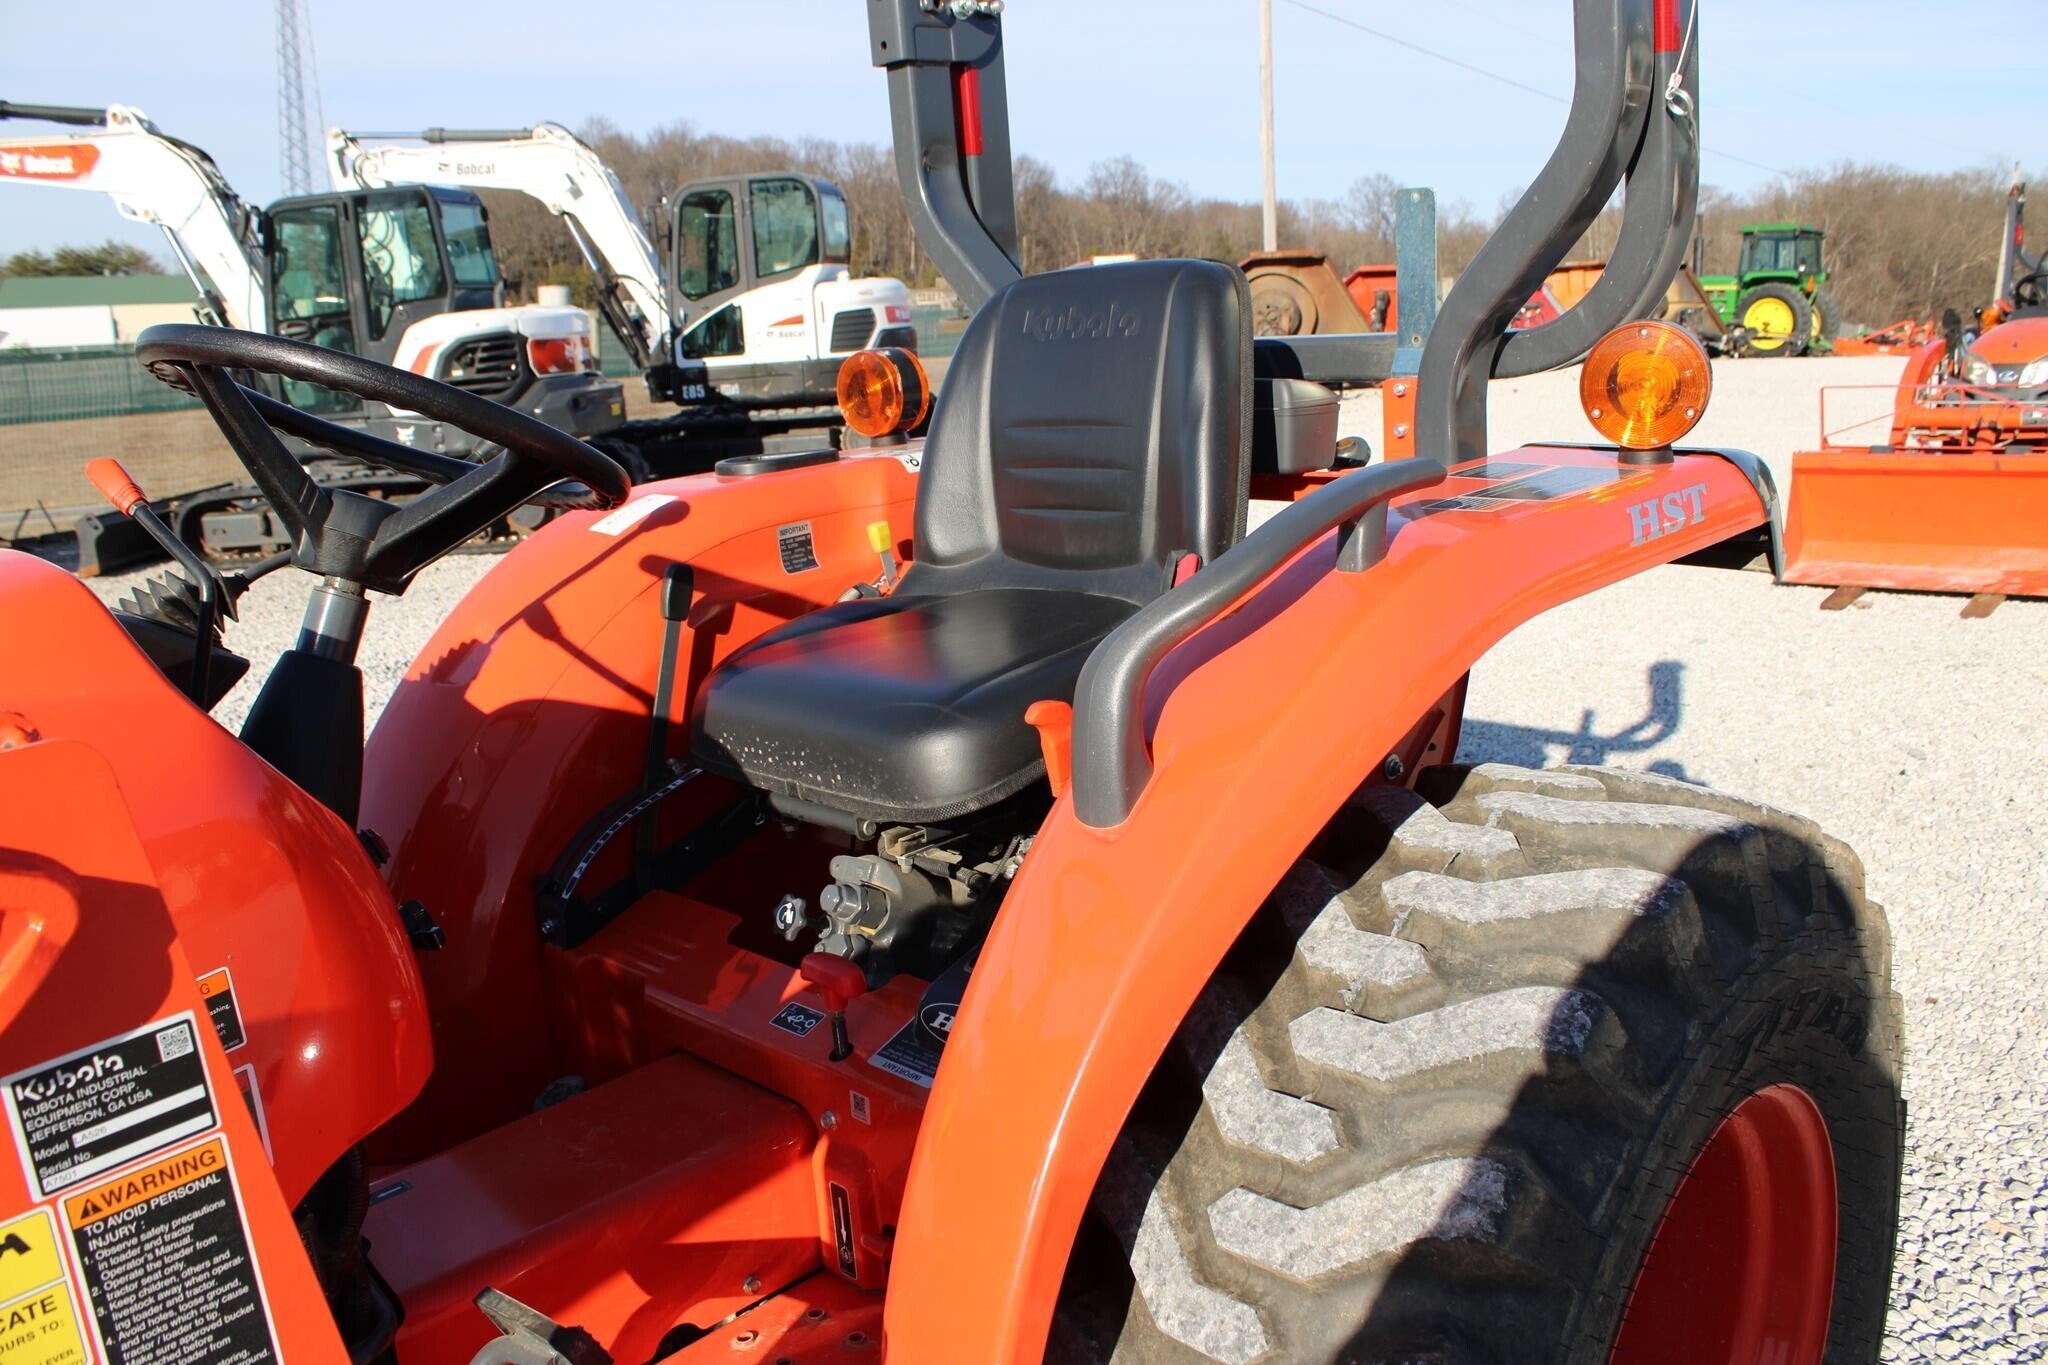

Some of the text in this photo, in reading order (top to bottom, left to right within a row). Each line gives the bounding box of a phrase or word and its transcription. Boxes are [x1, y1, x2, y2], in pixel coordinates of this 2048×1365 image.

[23, 154, 74, 174] Bobcat
[456, 163, 496, 175] Bobcat
[1023, 303, 1141, 342] Kubota
[682, 384, 705, 399] E85
[779, 523, 809, 536] IMPORTANT
[1626, 483, 1709, 548] HST
[16, 1054, 124, 1101] Kubota
[22, 1066, 148, 1120] KUBOTA INDUSTRIAL
[882, 1060, 922, 1082] IMPORTANT
[25, 1082, 140, 1132] EQUIPMENT CORP.
[108, 1097, 126, 1112] GA
[128, 1088, 153, 1105] USA
[34, 1140, 70, 1162] Model
[39, 1152, 94, 1178] Serial No.
[100, 1149, 217, 1208] WARNING
[84, 1174, 221, 1236] TO AVOID PERSONAL
[84, 1198, 226, 1266] 1. Observe safety precautions
[88, 1221, 138, 1252] INJURY
[98, 1223, 194, 1271] in loader and tractor
[91, 1234, 218, 1297] 2. Operate the loader from
[100, 1234, 194, 1280] Operator's Manual.
[106, 1260, 186, 1302] tractor seat only.
[108, 1294, 136, 1312] Keep
[181, 1260, 211, 1279] others
[212, 1250, 230, 1264] and
[112, 1256, 244, 1322] livestock away when operat-
[114, 1279, 218, 1332] ing loader and tractor.
[119, 1321, 146, 1342] Avoid
[178, 1296, 205, 1312] loose
[120, 1285, 249, 1352] and rocks which may cause
[123, 1340, 155, 1362] tractor
[162, 1322, 193, 1342] loader
[194, 1318, 204, 1327] to
[206, 1310, 220, 1322] tip.
[156, 1340, 177, 1357] sure
[179, 1318, 223, 1346] approved
[224, 1302, 255, 1324] bucket
[178, 1336, 232, 1365] loader from
[183, 1334, 214, 1354] before
